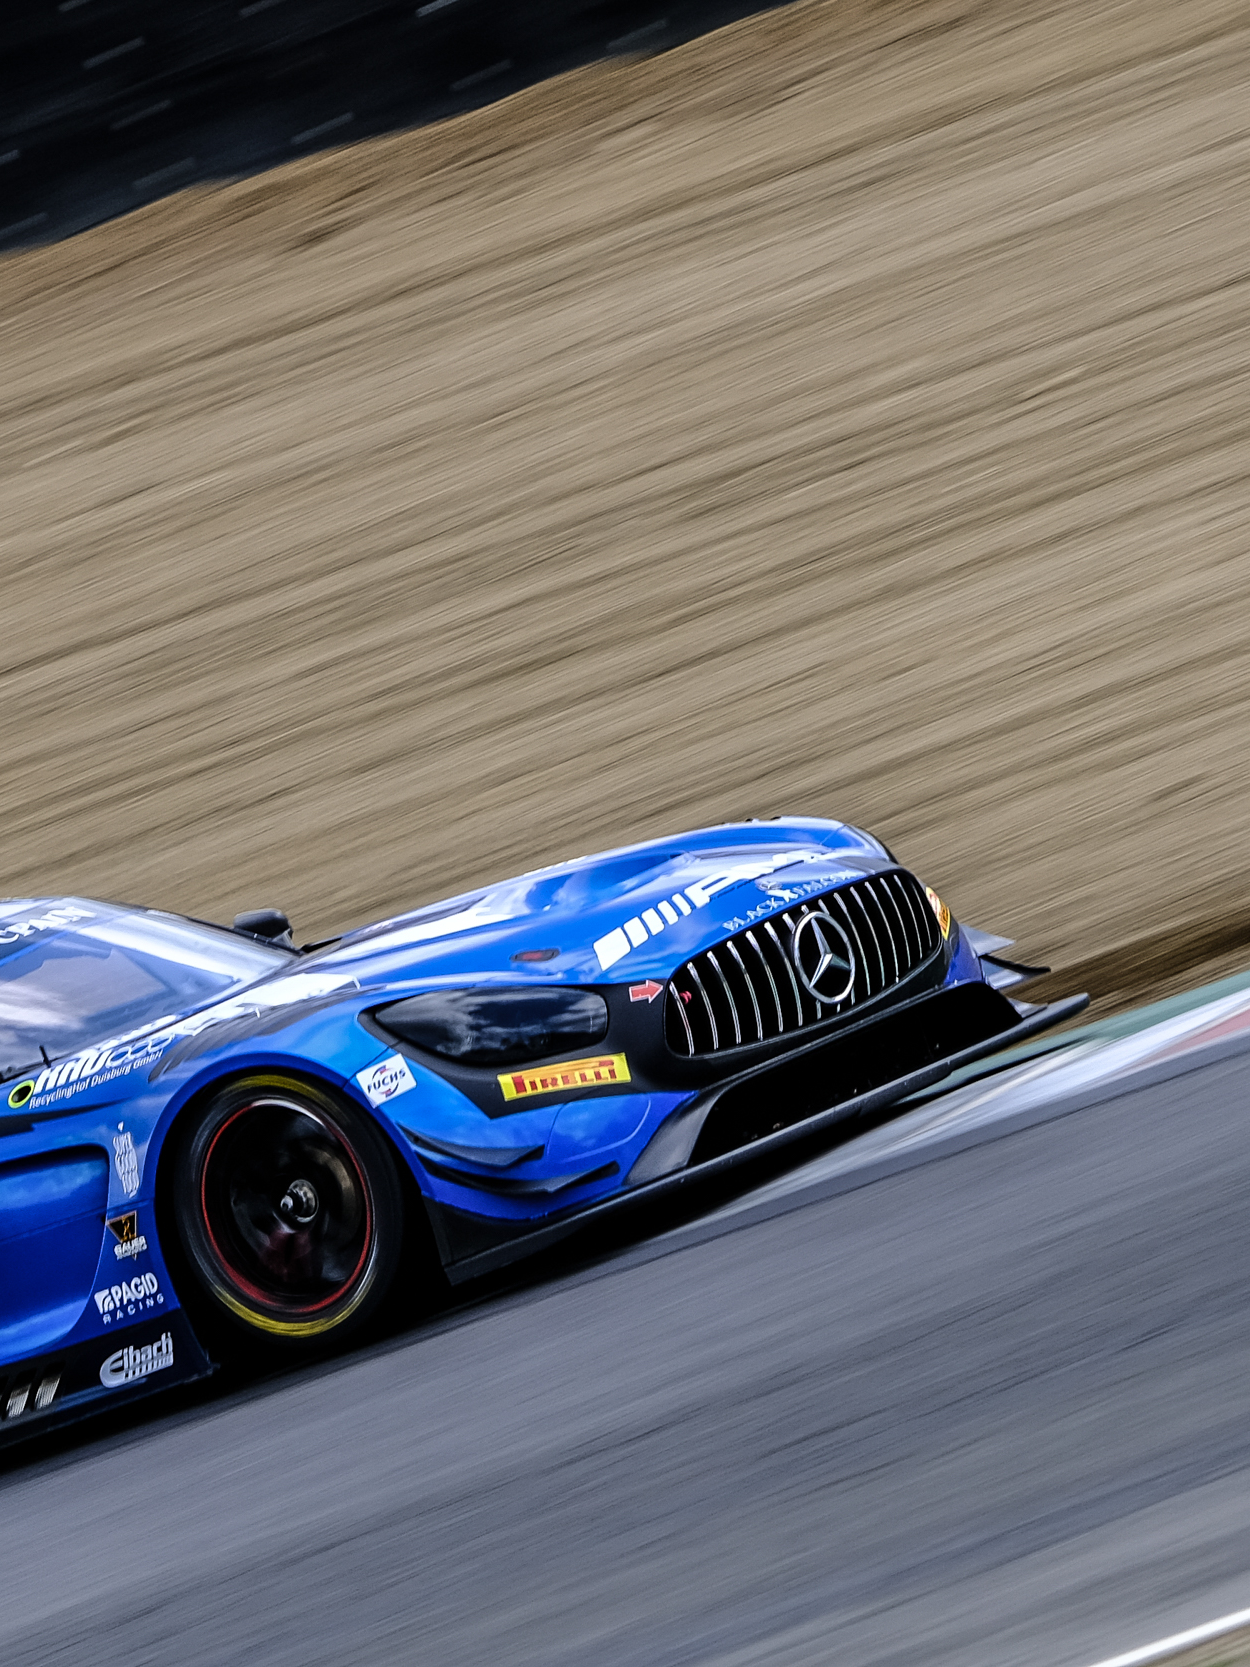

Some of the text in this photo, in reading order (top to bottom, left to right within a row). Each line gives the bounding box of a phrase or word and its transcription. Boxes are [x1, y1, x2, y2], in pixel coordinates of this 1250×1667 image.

[91, 1063, 132, 1088] Duisburg
[367, 1067, 406, 1094] FUCHS
[511, 1057, 617, 1094] PIRELLI
[111, 1272, 158, 1308] PAGID
[102, 1293, 164, 1325] RACING
[99, 1331, 174, 1388] Eibach
